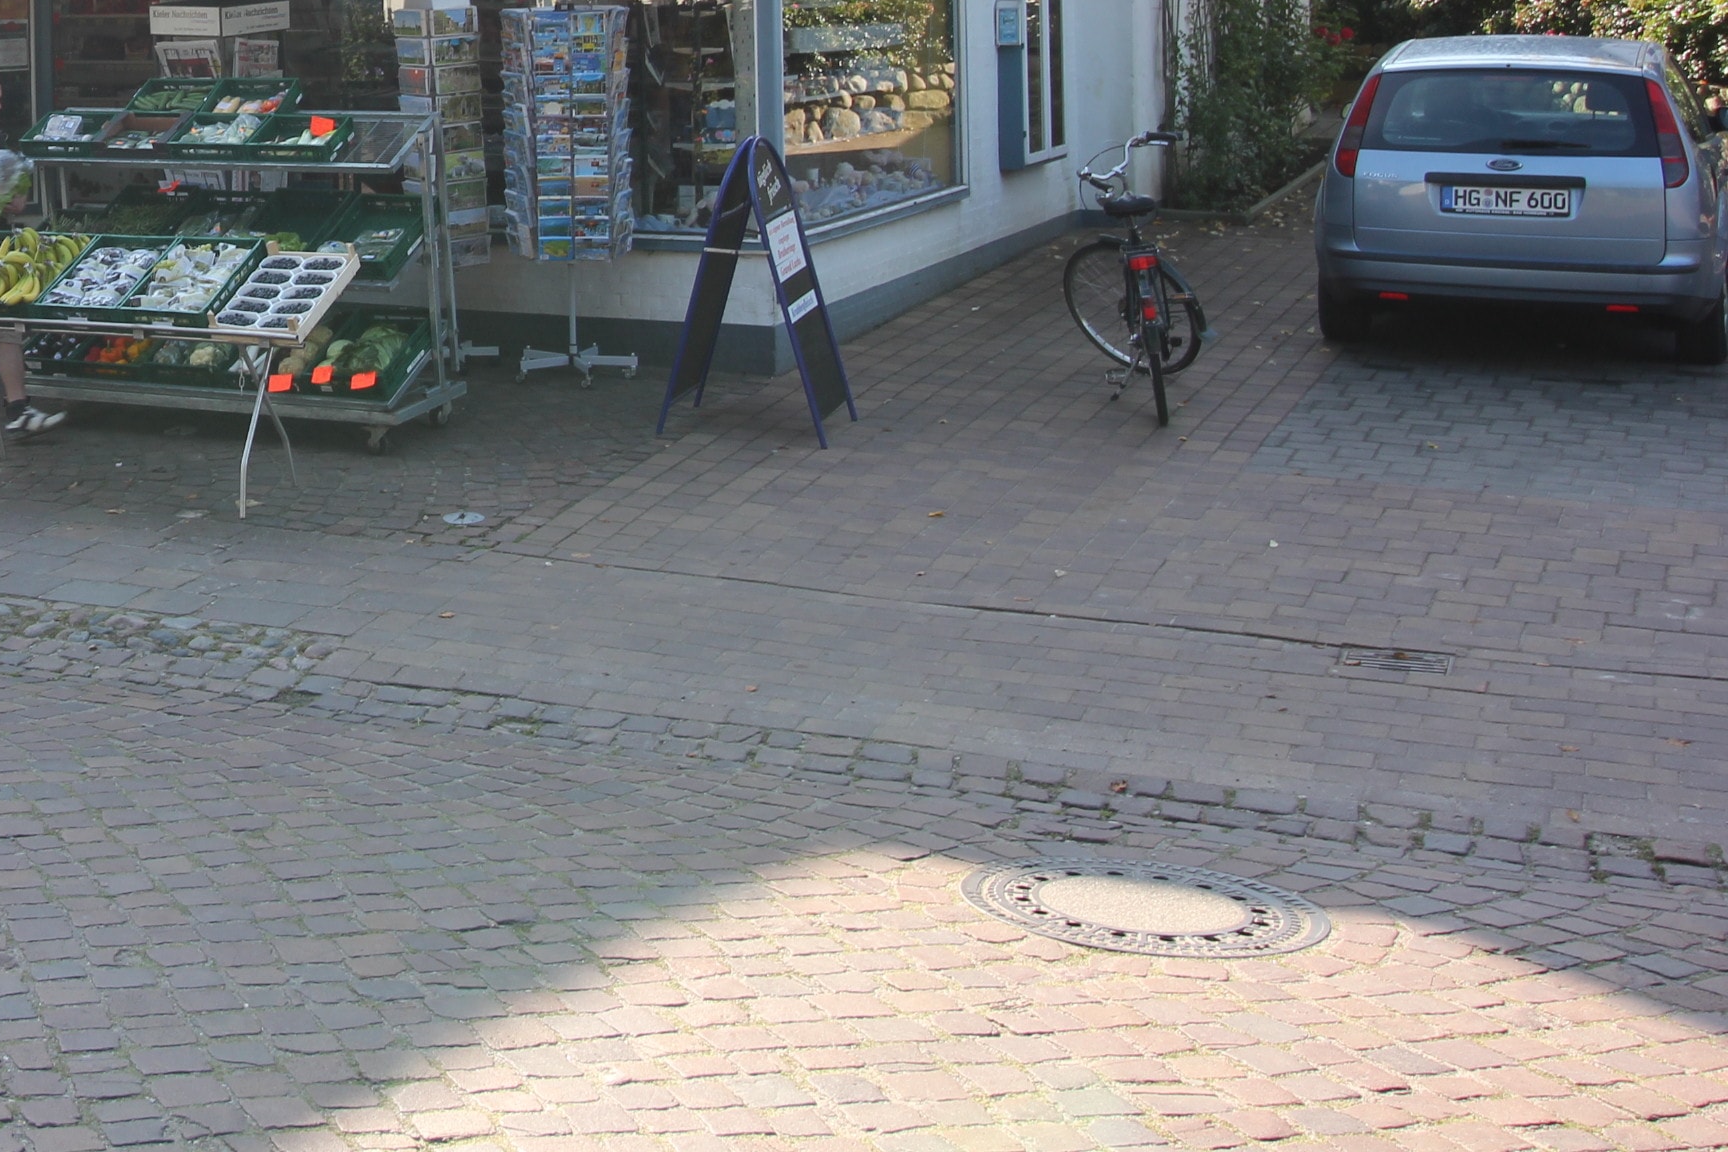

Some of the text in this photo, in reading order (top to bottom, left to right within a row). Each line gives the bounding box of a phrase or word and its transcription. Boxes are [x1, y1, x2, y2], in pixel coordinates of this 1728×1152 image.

[152, 9, 208, 19] Kieler Nachrichten
[1454, 189, 1567, 210] HG NF 600
